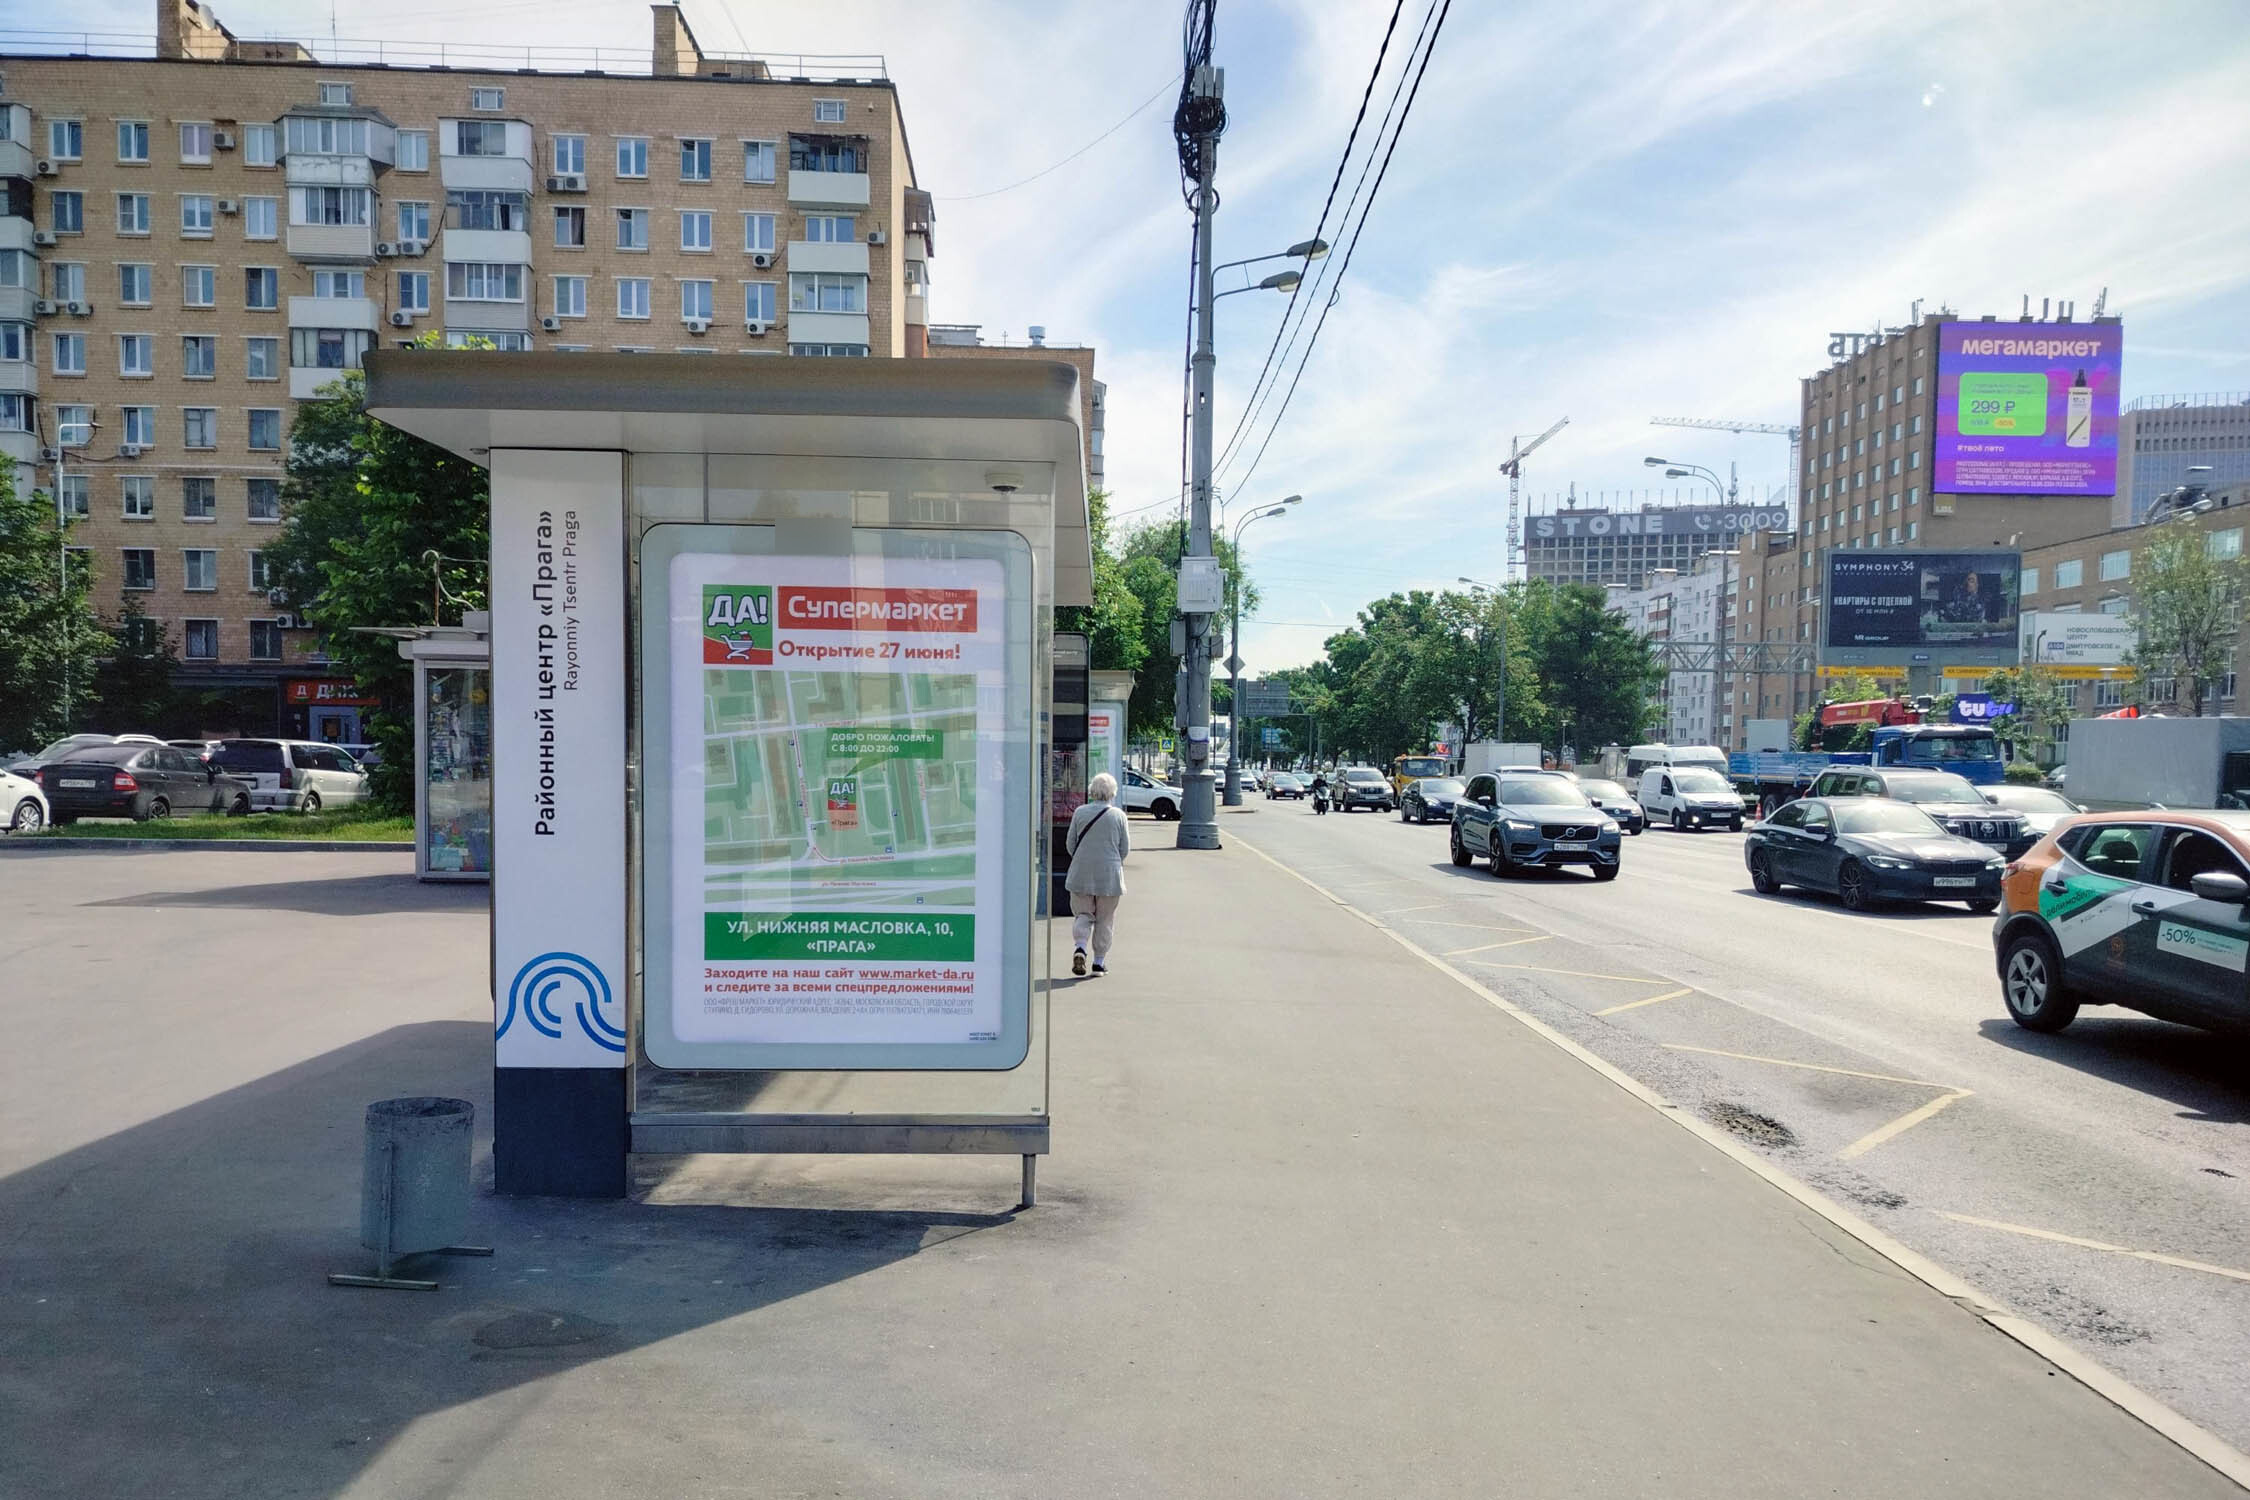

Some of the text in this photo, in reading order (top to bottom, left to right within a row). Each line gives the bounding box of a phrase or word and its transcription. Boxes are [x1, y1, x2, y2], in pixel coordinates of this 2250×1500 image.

[1961, 339, 2102, 360] мегамаркет
[1971, 400, 2000, 414] 299
[1536, 514, 1664, 537] STONE
[1835, 561, 1914, 571] SYMPHONY 34
[562, 510, 580, 691] Rayonniy Tsentr Praga
[1834, 596, 1870, 606] КВАРТИРЫ
[1877, 595, 1913, 606] ОТДЕЛКОЙ
[708, 595, 769, 627] ДА!
[788, 596, 968, 622] Супермаркет
[778, 639, 961, 661] Открытие 27 июня!
[533, 510, 558, 836] Районный центр «Прага»
[831, 733, 935, 743] ДОБРО ПОЖАЛОВАТЬ!
[831, 744, 900, 753] С 8:00 ДО 22:00
[830, 782, 854, 795] ДА!
[727, 921, 954, 936] УЛ. НИЖНЯЯ МАСЛОВКА, 10,
[2161, 928, 2197, 945] -50%
[807, 940, 876, 953] «ПРАГА»
[704, 968, 974, 980] Заходите на наш сайт www.market-da.ru
[704, 983, 974, 995] и следите за всеми спецпредложениями!
